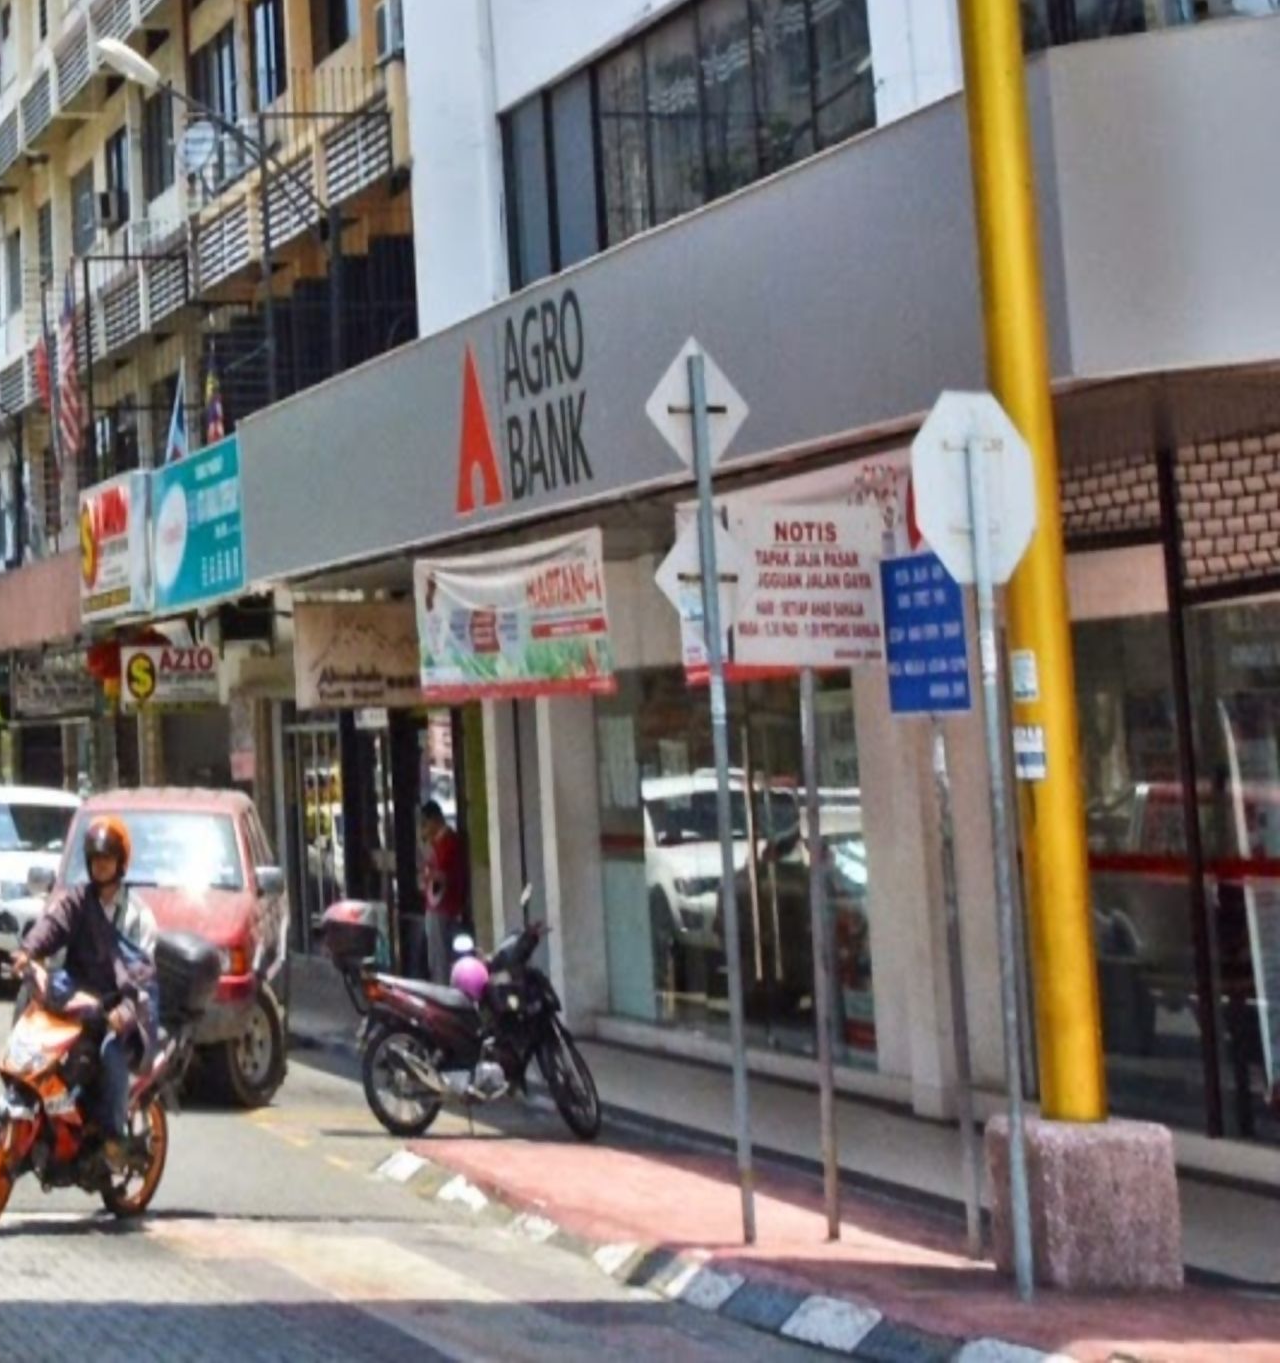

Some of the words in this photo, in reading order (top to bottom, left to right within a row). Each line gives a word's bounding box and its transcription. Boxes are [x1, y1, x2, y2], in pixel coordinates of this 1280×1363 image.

[504, 288, 584, 404] AGRO
[507, 390, 594, 501] BANK
[774, 521, 837, 542] NOTIS
[160, 647, 213, 671] AZIO
